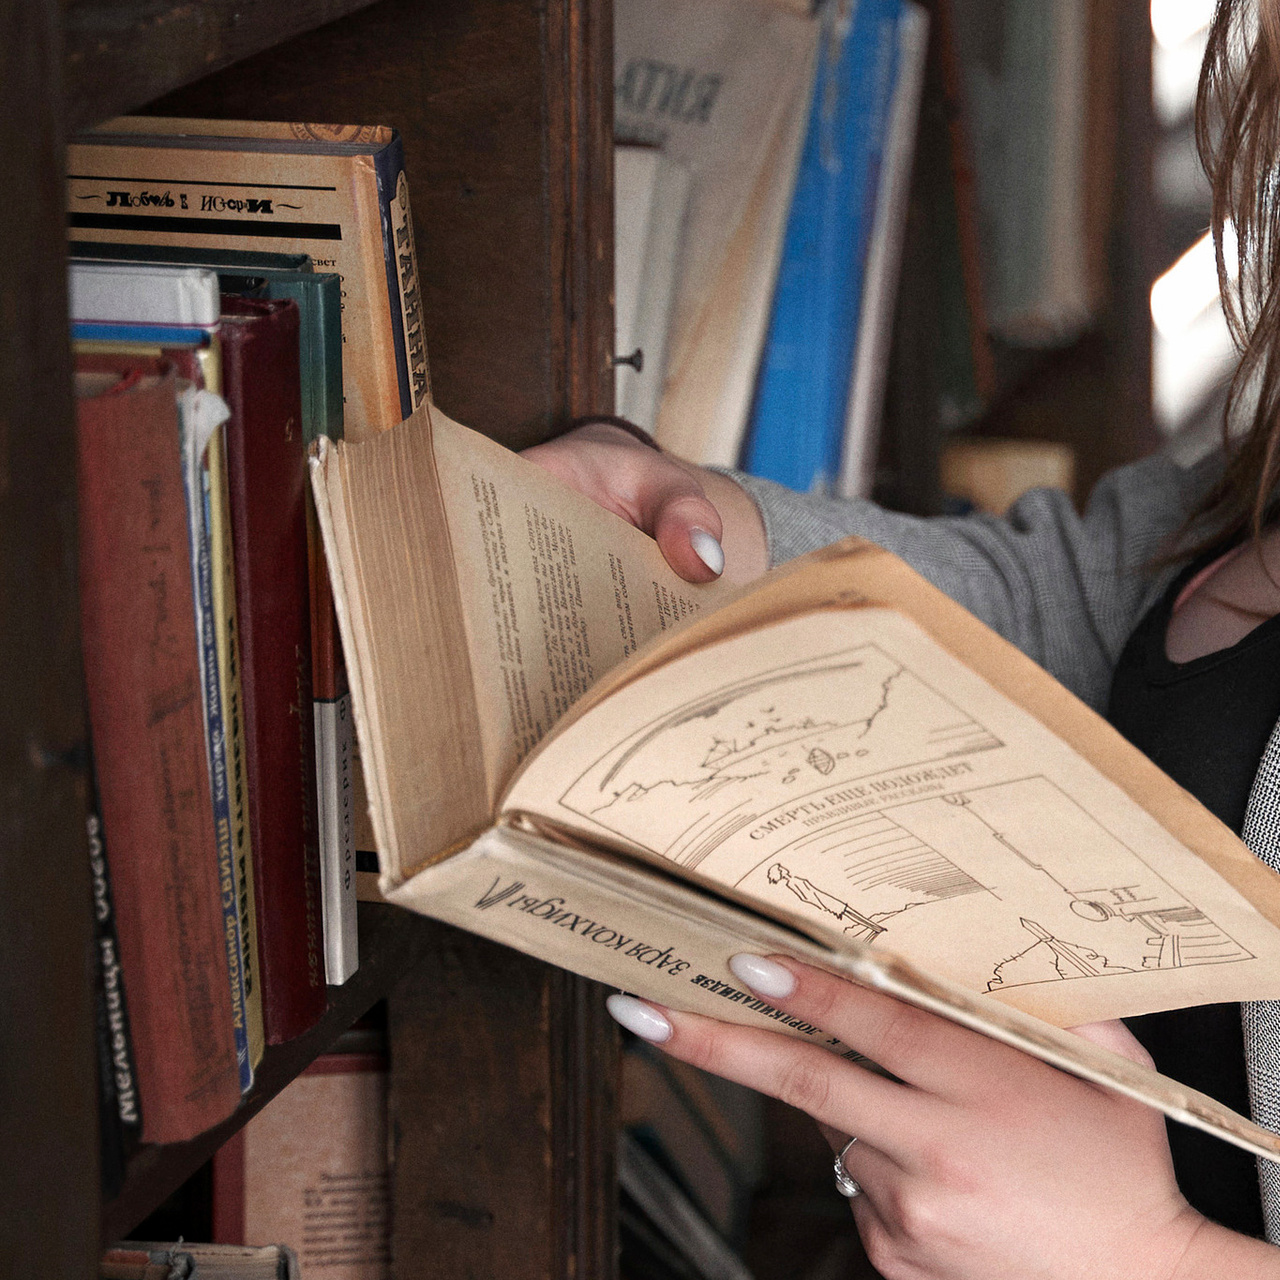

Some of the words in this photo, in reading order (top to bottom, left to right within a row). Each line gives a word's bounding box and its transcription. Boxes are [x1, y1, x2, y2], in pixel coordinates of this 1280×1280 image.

[566, 527, 576, 566] танкист
[536, 578, 546, 614] братом
[573, 574, 583, 608] Пишет
[617, 558, 628, 599] событии
[569, 593, 580, 631] братом
[662, 587, 671, 617] Почти
[625, 603, 637, 651] памятном
[750, 797, 826, 841] СМЕРТЬ
[828, 784, 868, 806] ЕЩЕ
[874, 759, 973, 793] ПОДОЖДЕТ
[801, 797, 877, 827] ПРАВДИВЫЕ
[217, 817, 234, 908] СВИЯШ
[505, 892, 628, 951] КОЛХИДЫ
[224, 914, 243, 1030] Александр
[626, 940, 690, 978] ЗАРЯ
[99, 939, 139, 1121] Мельницы
